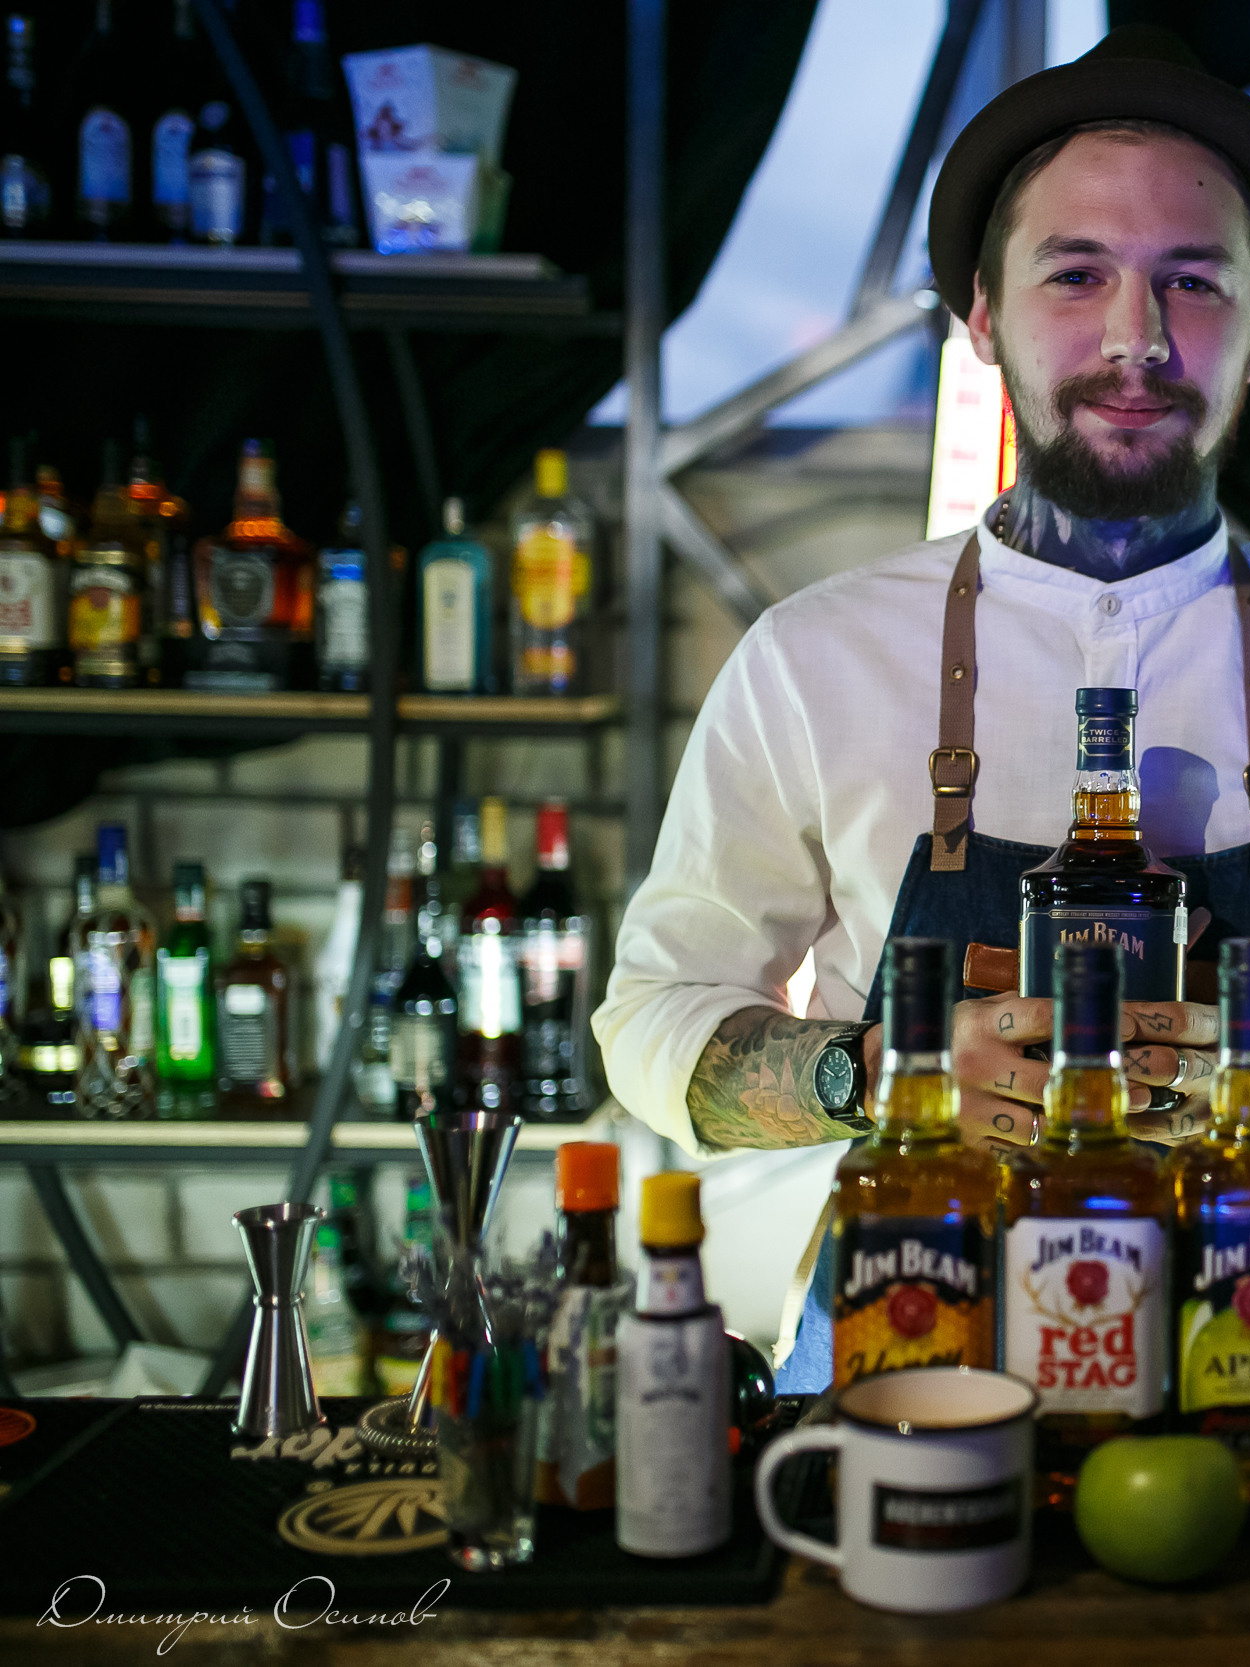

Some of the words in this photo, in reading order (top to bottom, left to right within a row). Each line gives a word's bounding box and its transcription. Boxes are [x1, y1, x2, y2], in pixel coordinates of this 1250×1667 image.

[1094, 921, 1145, 961] BEAM
[843, 1248, 897, 1299] JIM
[900, 1238, 977, 1298] BEAM
[1030, 1234, 1074, 1272] JIM
[1079, 1226, 1141, 1273] BEAM
[1193, 1244, 1247, 1291] JIM
[1038, 1313, 1135, 1358] red
[1037, 1361, 1137, 1389] STAG
